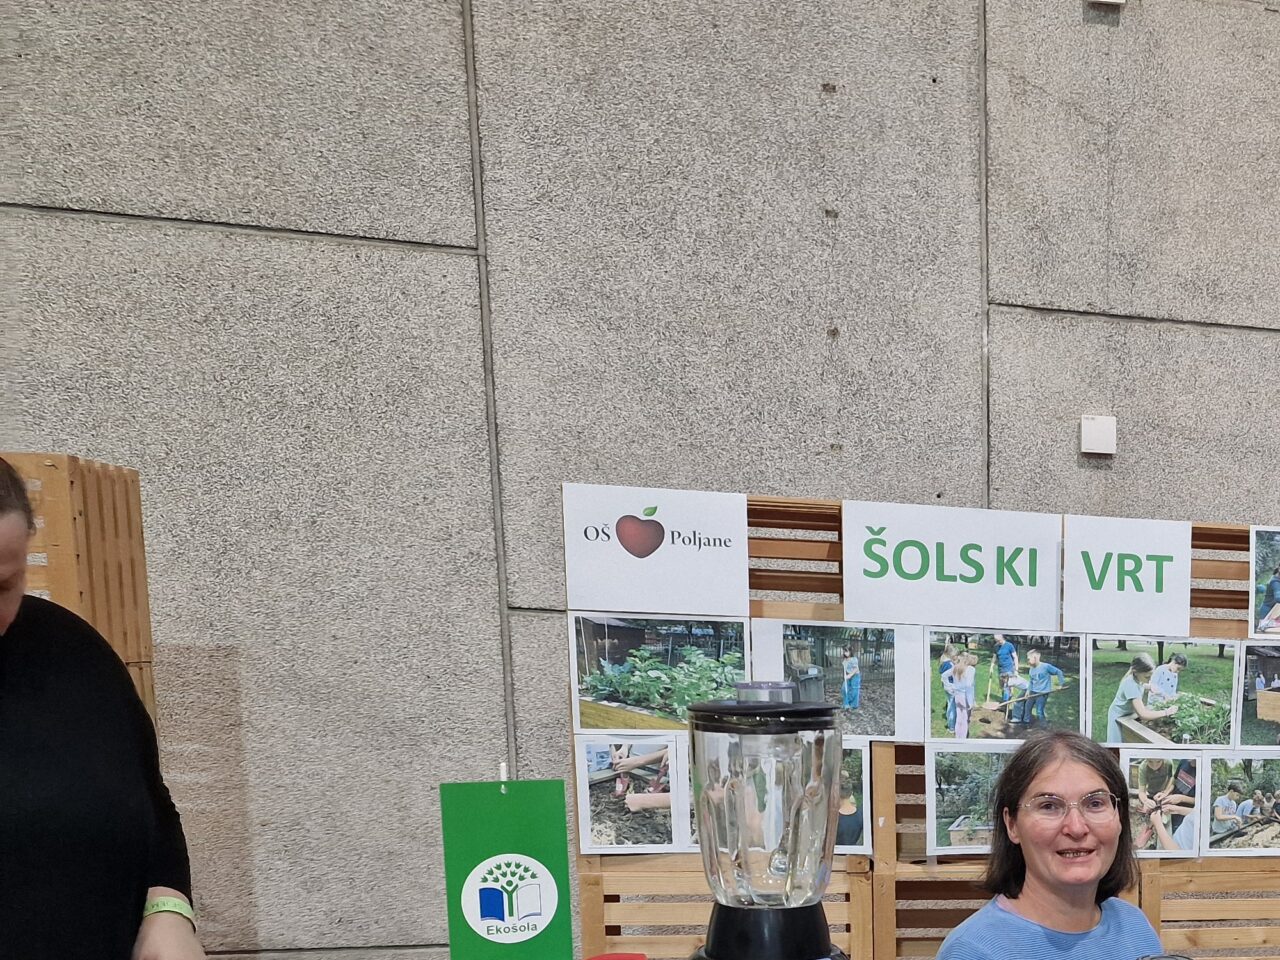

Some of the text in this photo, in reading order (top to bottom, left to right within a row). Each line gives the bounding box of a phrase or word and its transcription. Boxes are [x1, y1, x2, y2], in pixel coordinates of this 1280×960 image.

[583, 523, 732, 552] OŠ Poljane
[1081, 551, 1174, 593] VRT
[486, 922, 538, 935] Ekošola
